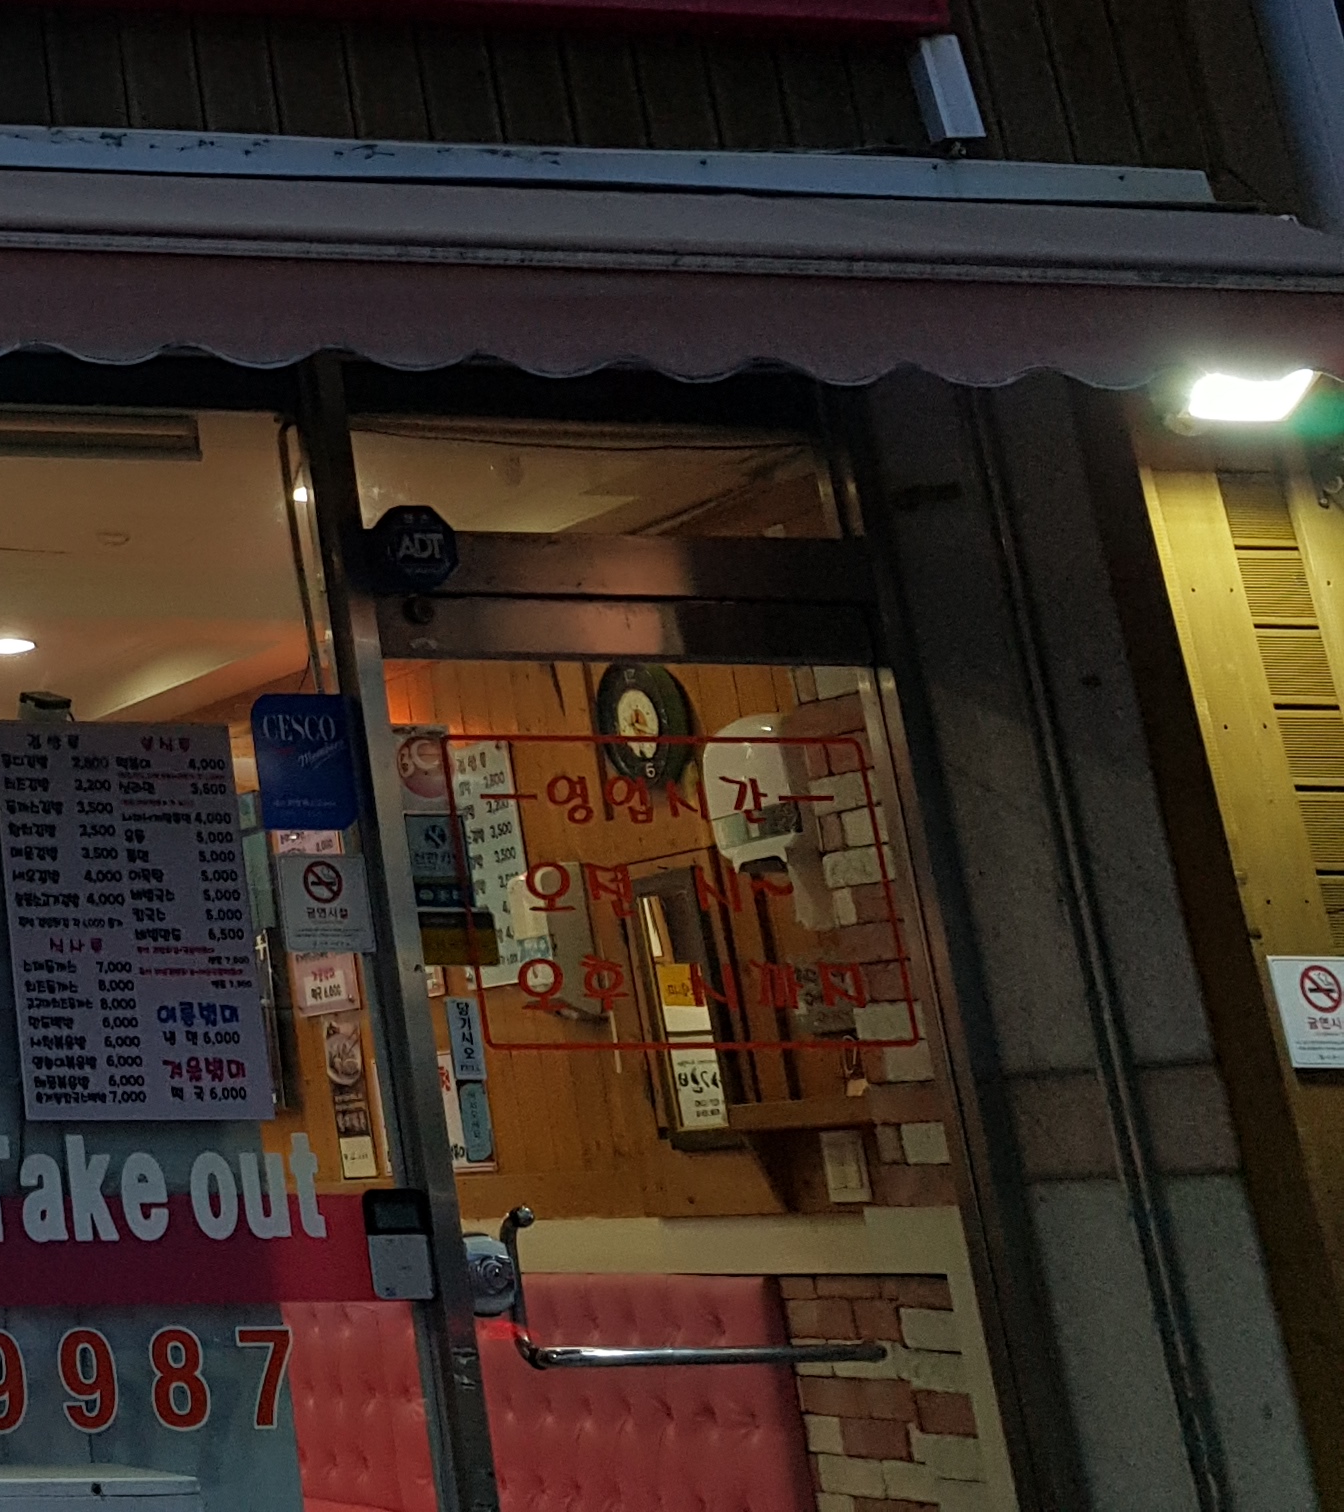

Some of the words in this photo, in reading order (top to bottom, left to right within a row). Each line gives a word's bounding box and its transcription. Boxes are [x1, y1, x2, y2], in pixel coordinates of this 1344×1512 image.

[398, 532, 445, 559] ADT
[262, 714, 336, 742] CESCO
[188, 758, 226, 771] 4,000
[547, 775, 768, 824] 영업시간
[194, 812, 232, 825] 4,000
[84, 870, 122, 883] 4,000
[87, 893, 126, 907] 4,000
[96, 961, 132, 974] 7,000
[518, 955, 629, 1011] 오후
[100, 998, 136, 1010] 8,000
[102, 1017, 139, 1030] 6,000
[456, 1001, 476, 1060] 당기시오
[104, 1036, 140, 1049] 6,000
[203, 1031, 240, 1045] 6,000
[106, 1055, 143, 1068] 6,000
[108, 1075, 145, 1088] 6,000
[109, 1091, 147, 1104] 7,000
[210, 1087, 247, 1101] 6,000
[190, 1132, 327, 1241] out
